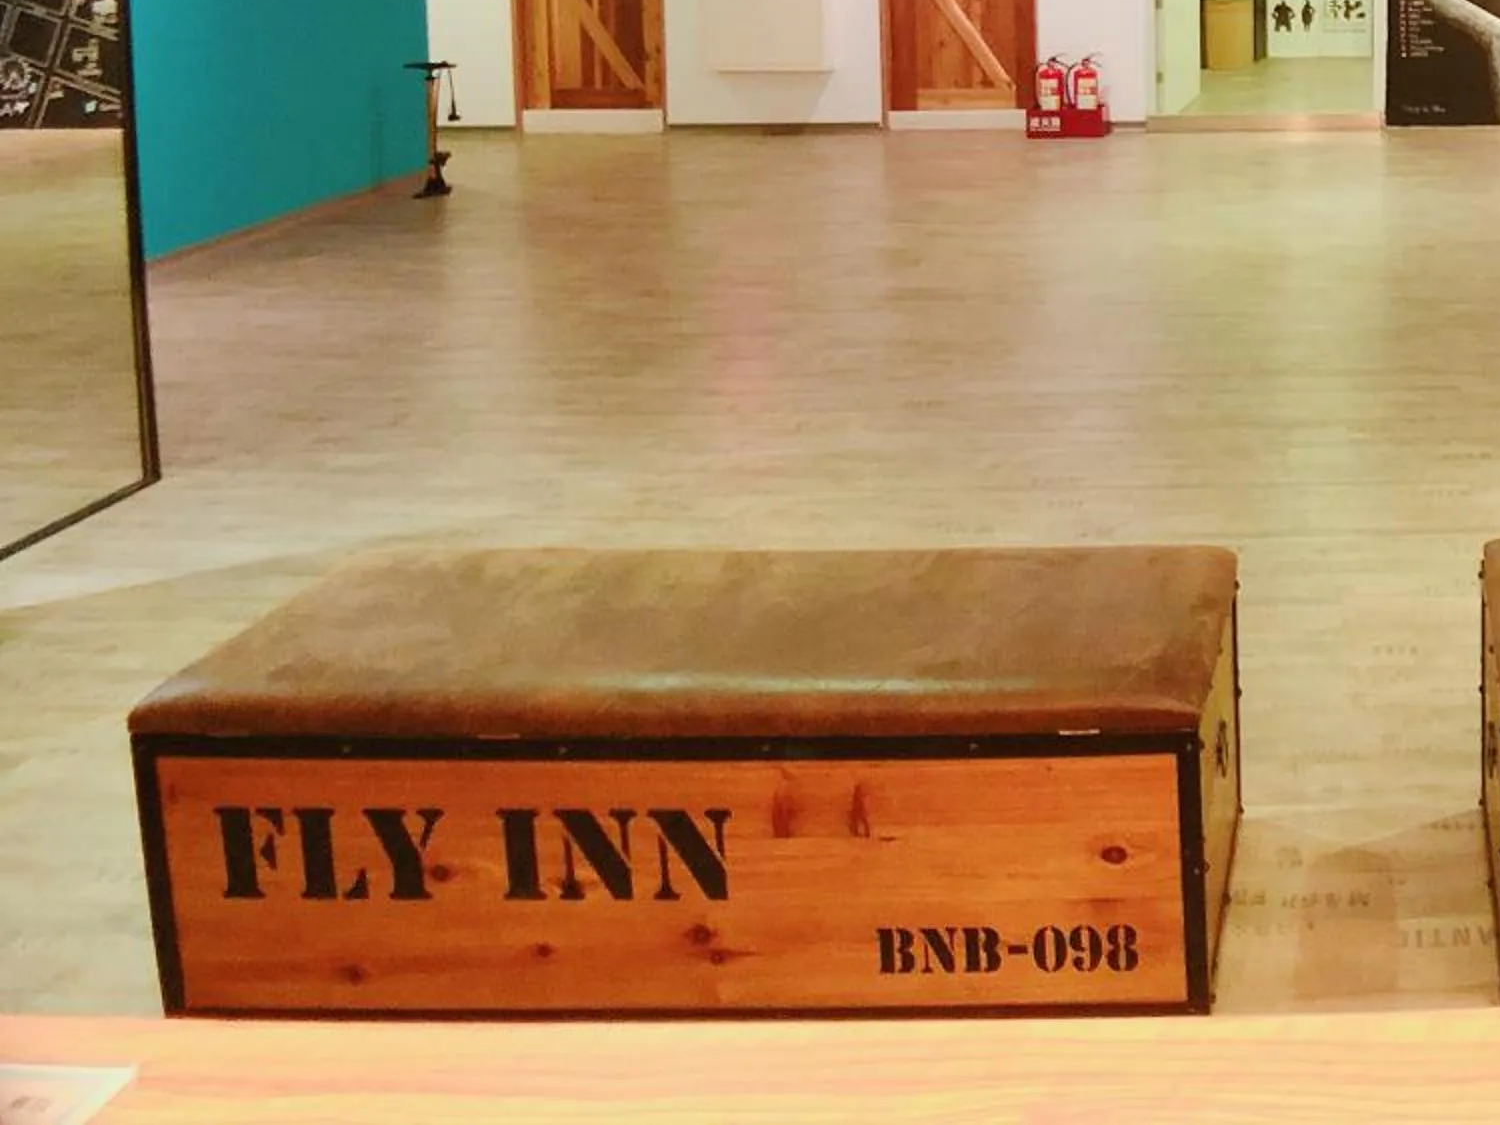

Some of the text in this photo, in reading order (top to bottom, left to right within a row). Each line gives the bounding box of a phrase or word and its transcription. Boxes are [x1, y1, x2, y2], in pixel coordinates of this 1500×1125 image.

[212, 806, 731, 901] FLY INN
[877, 925, 1140, 976] BNB-098
